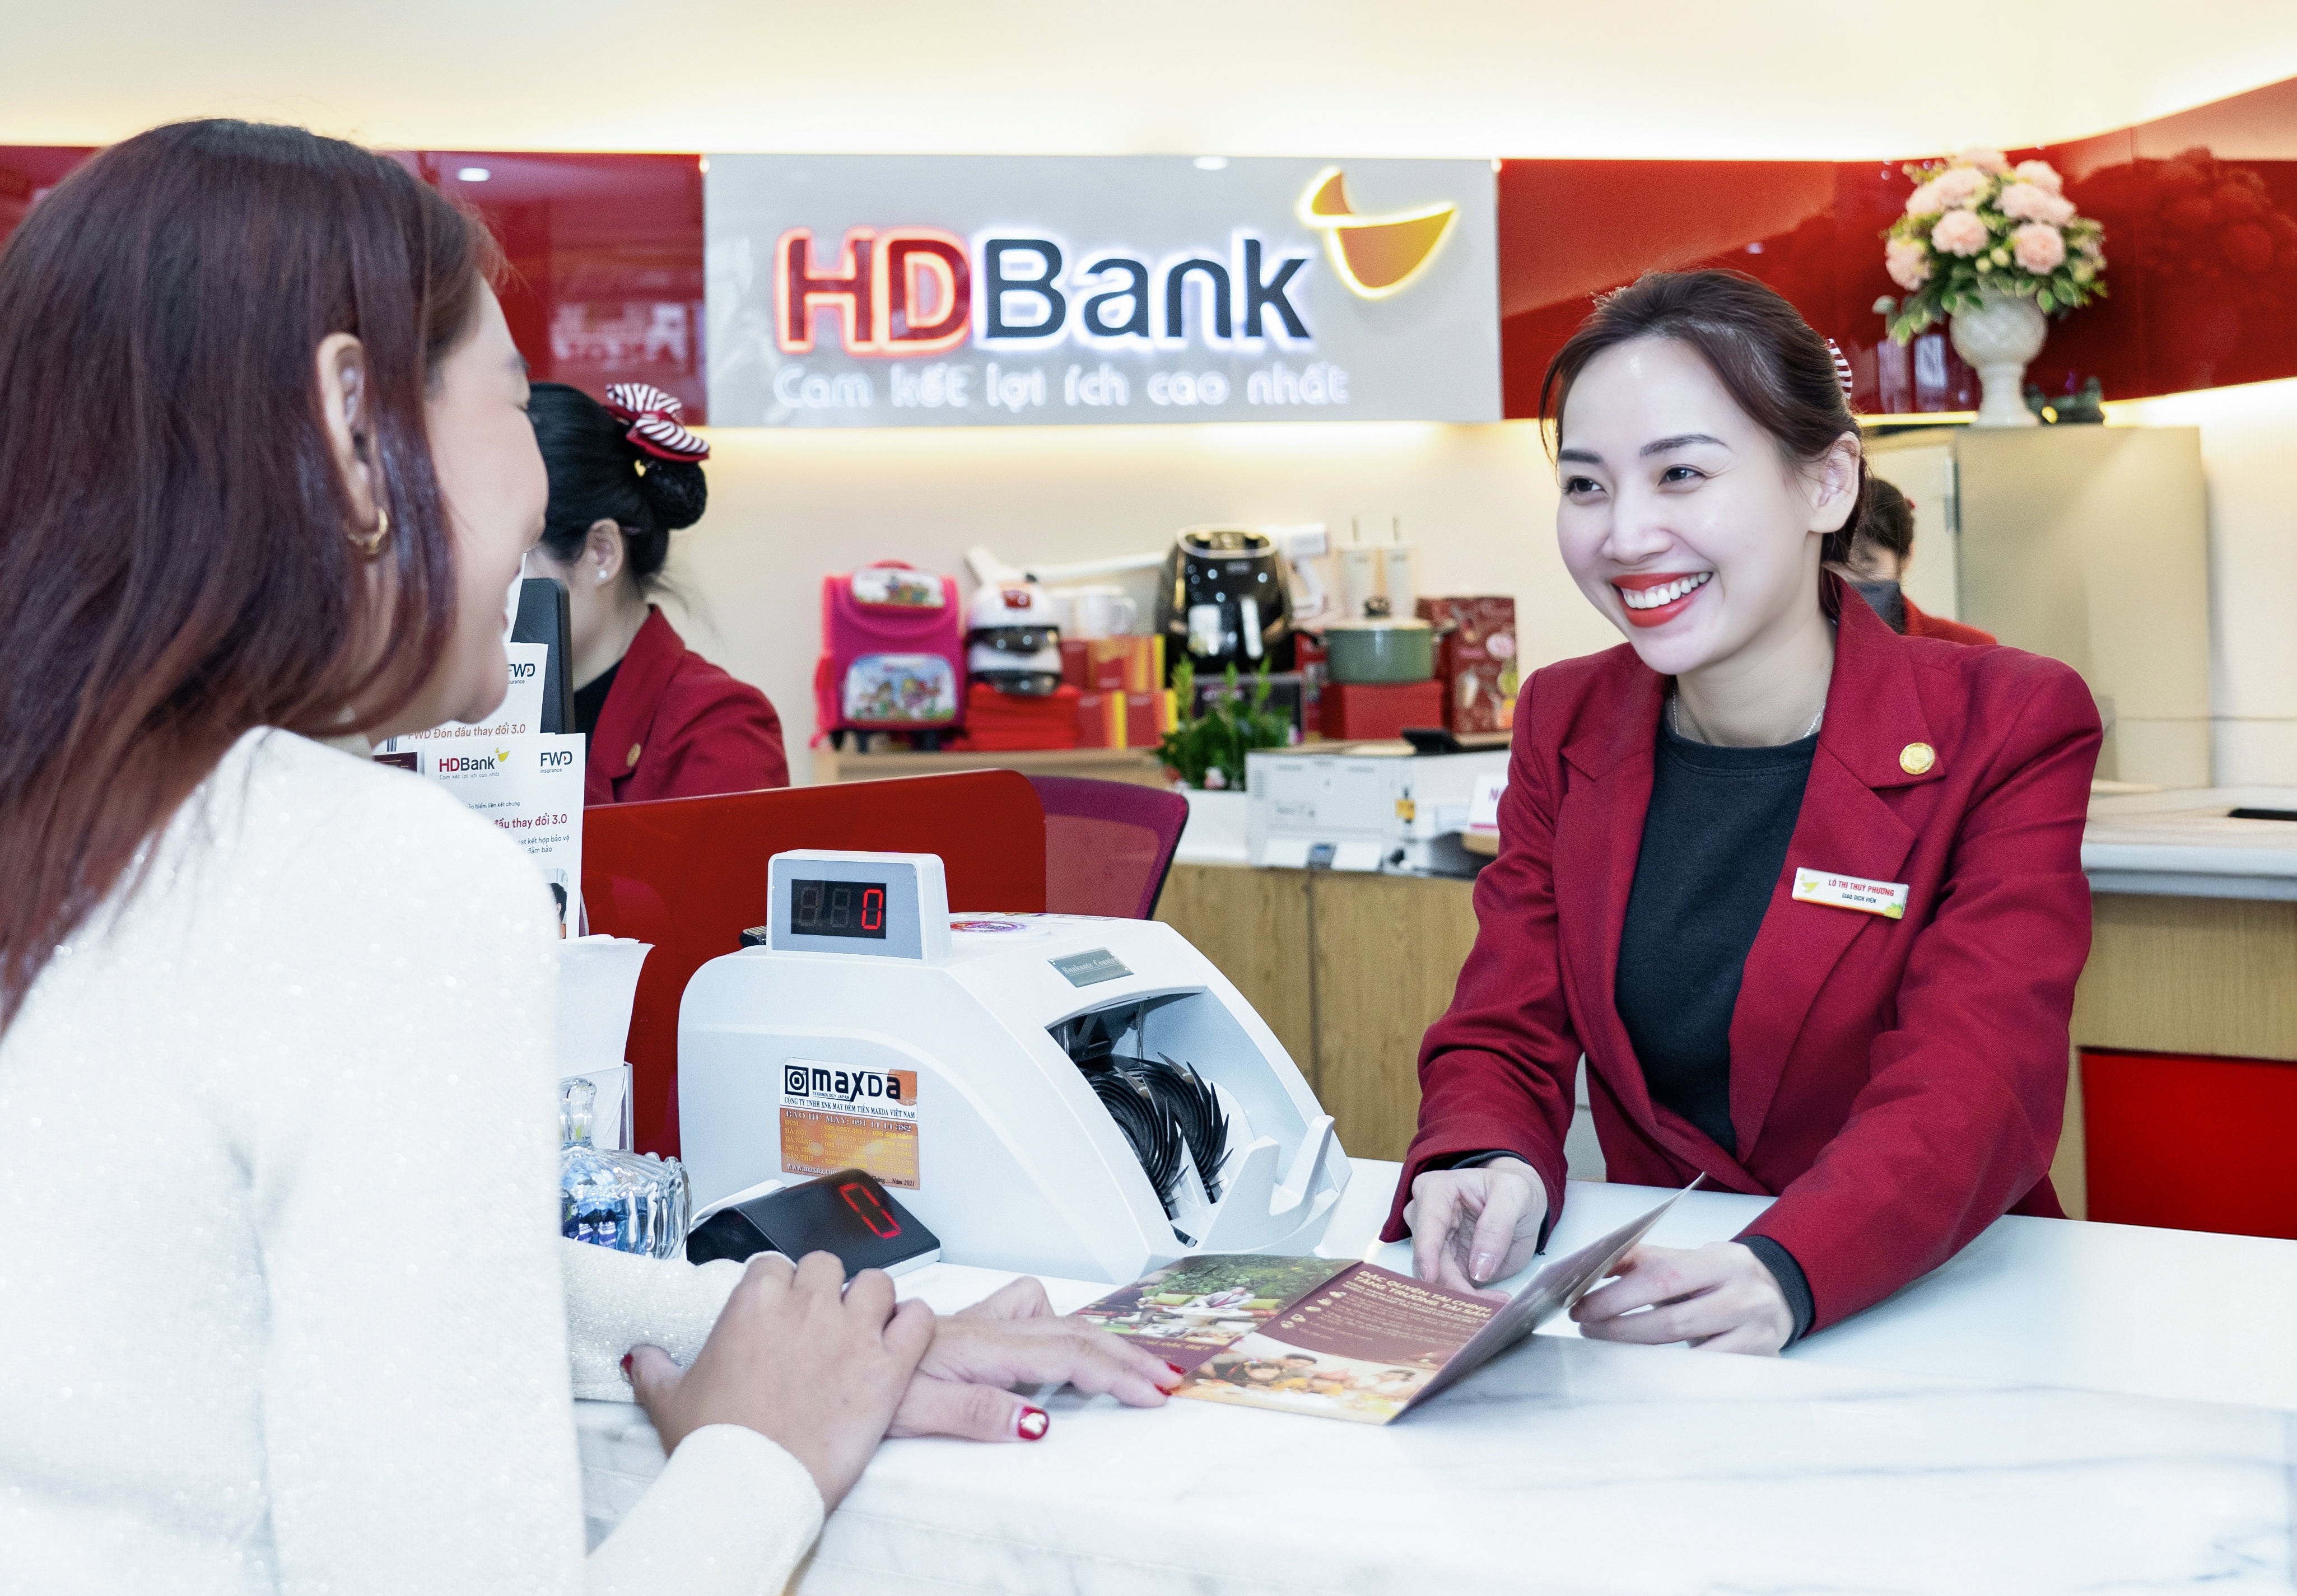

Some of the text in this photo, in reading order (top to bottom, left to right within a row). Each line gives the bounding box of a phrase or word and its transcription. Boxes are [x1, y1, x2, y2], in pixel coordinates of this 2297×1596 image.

[781, 232, 1314, 344] HDBank
[774, 360, 1350, 413] Cam kết lợi ích cao nhất
[434, 729, 452, 738] Đón
[455, 726, 471, 737] đầu
[474, 726, 493, 736] thay
[495, 722, 509, 735] đổi
[511, 724, 526, 734] 3.0
[439, 756, 495, 772] HDBank
[540, 751, 572, 767] FWD
[512, 818, 533, 829] thay
[535, 813, 549, 826] đổi
[552, 814, 567, 824] 3.0
[861, 889, 883, 930] 0
[870, 1107, 888, 1116] MAXDA
